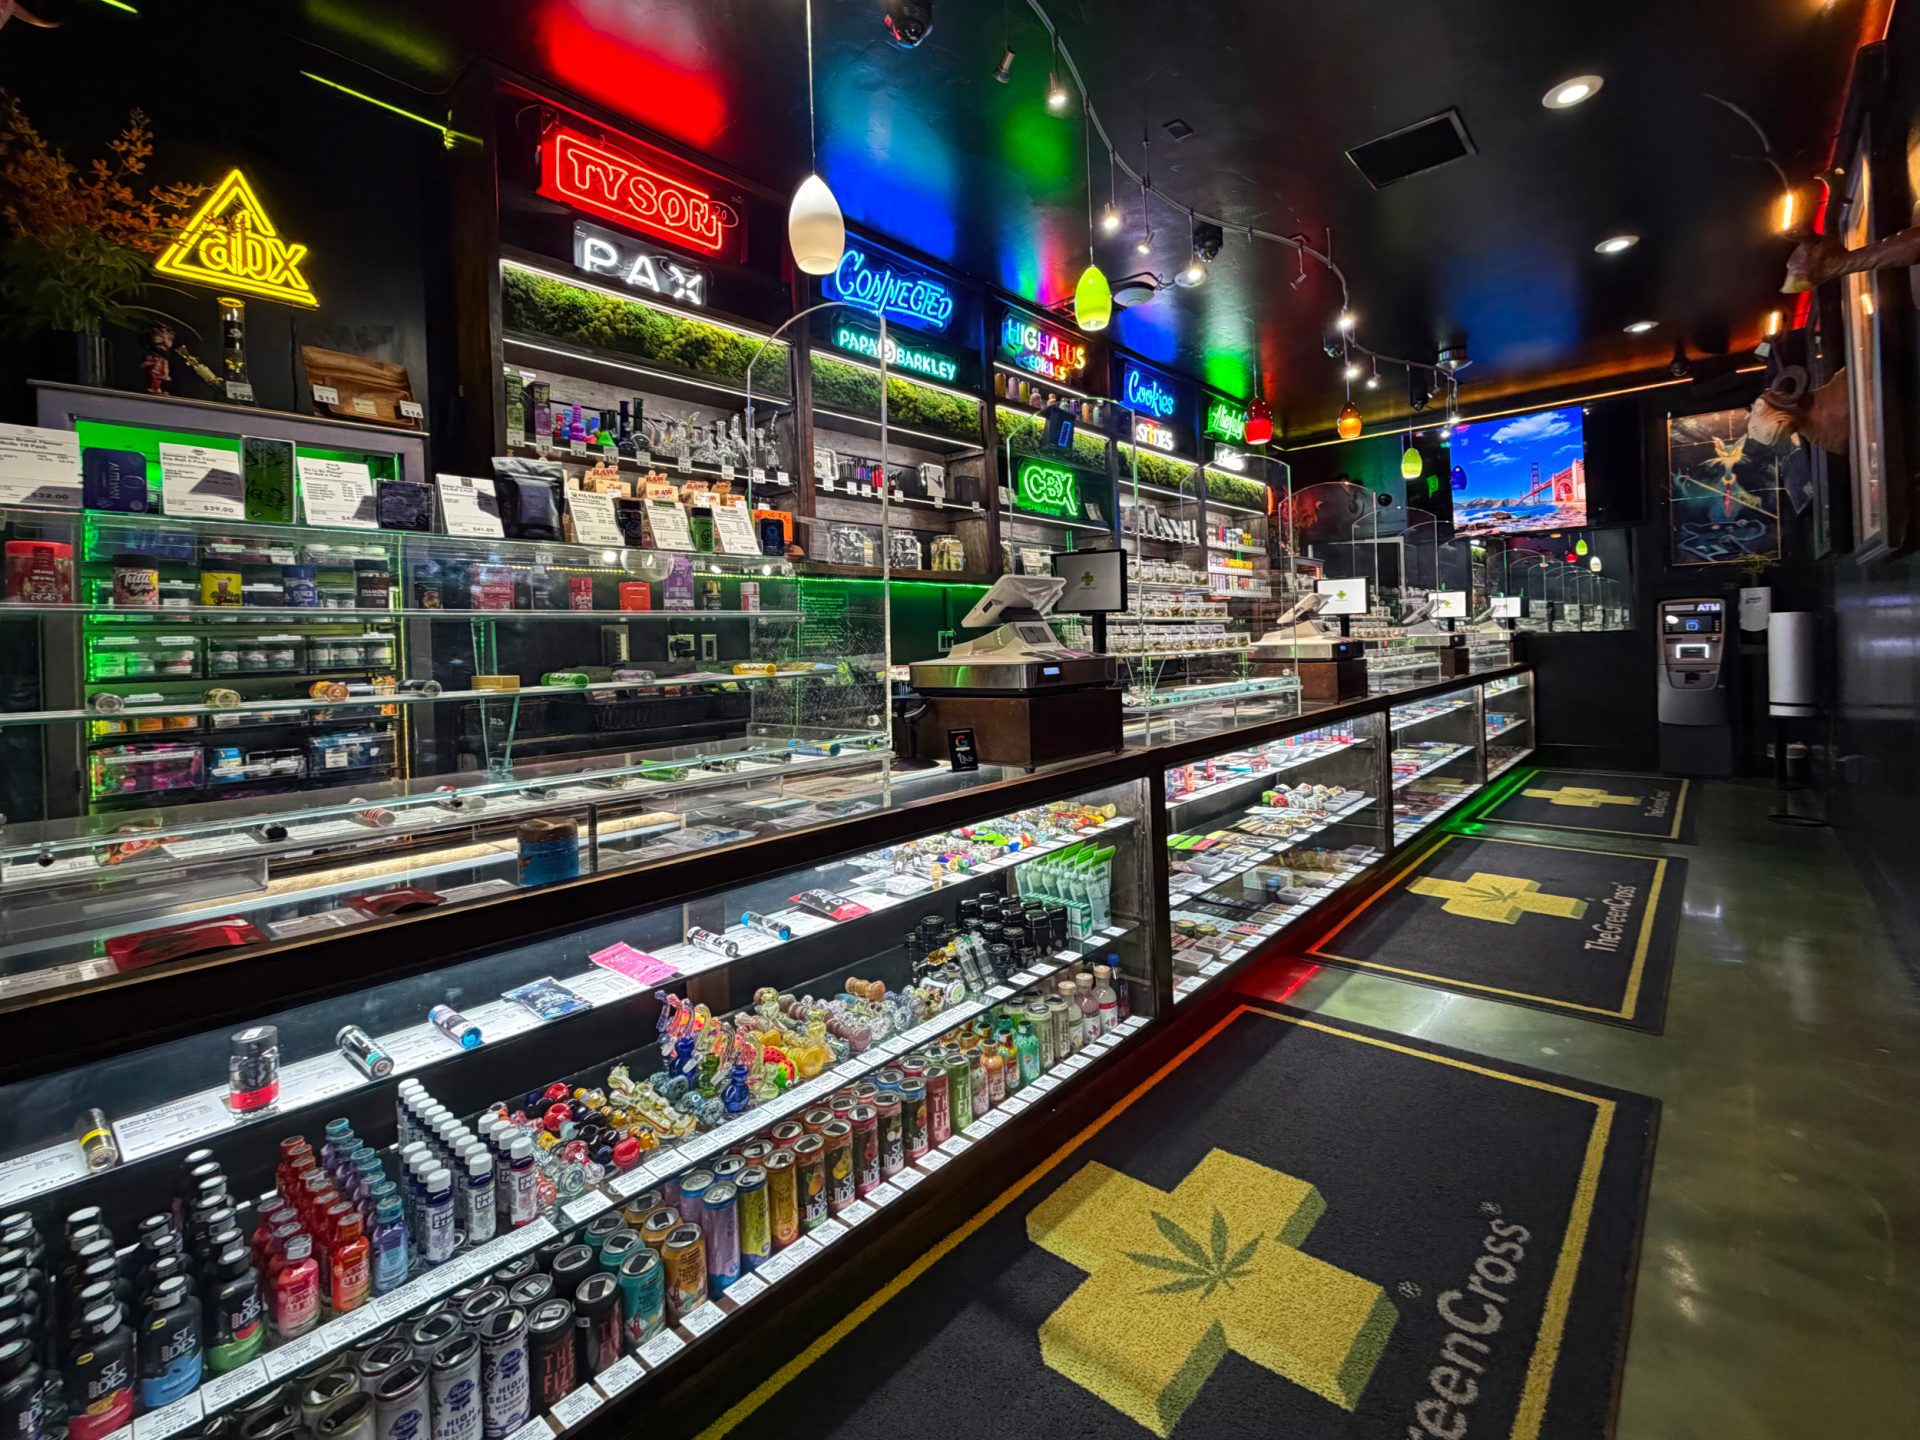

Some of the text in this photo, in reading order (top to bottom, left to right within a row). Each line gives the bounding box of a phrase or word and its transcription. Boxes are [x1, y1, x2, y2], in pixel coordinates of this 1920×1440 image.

[567, 148, 717, 237] TYSON
[199, 208, 310, 290] abx
[584, 237, 703, 305] PAX
[839, 329, 957, 381] PAPA BARKLEY
[1007, 318, 1086, 370] HIGHATUS
[1128, 370, 1175, 417] Cookies
[203, 504, 235, 513] $39.00
[1696, 603, 1721, 612] ATM
[173, 1326, 191, 1344] ST
[101, 1360, 121, 1380] ST
[498, 1377, 524, 1395] HIGH
[446, 1407, 475, 1427] HIGH
